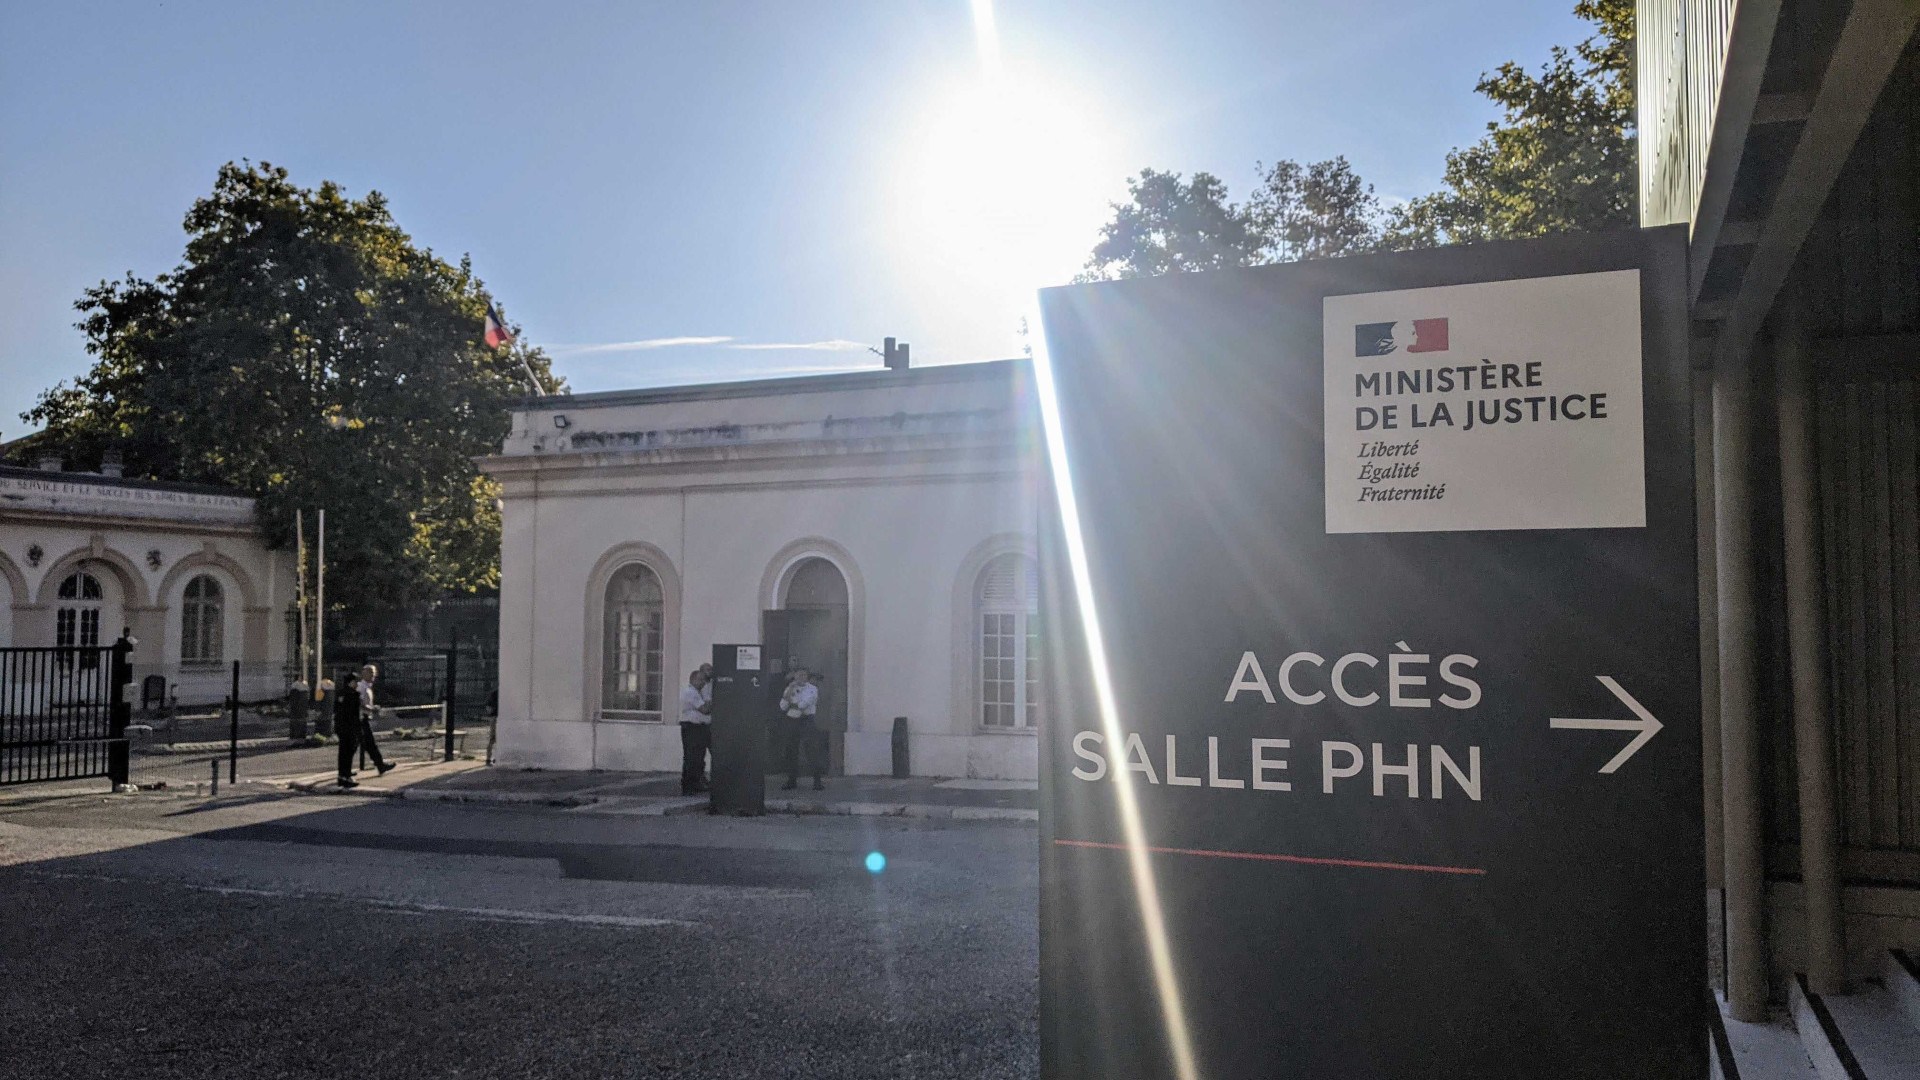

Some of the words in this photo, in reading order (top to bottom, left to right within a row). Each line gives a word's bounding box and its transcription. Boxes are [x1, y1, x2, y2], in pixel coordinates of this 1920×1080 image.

[1355, 359, 1543, 397] MINISTÈRE
[1356, 406, 1398, 431] DE
[1411, 402, 1454, 428] LA
[1462, 393, 1608, 431] JUSTICE
[1357, 440, 1420, 458] Liberté
[1357, 461, 1420, 483] Égalité
[1357, 483, 1446, 502] Fraternité
[1223, 640, 1482, 709] ACCÈS
[1071, 730, 1292, 792] SALLE
[1321, 740, 1482, 801] PHN
